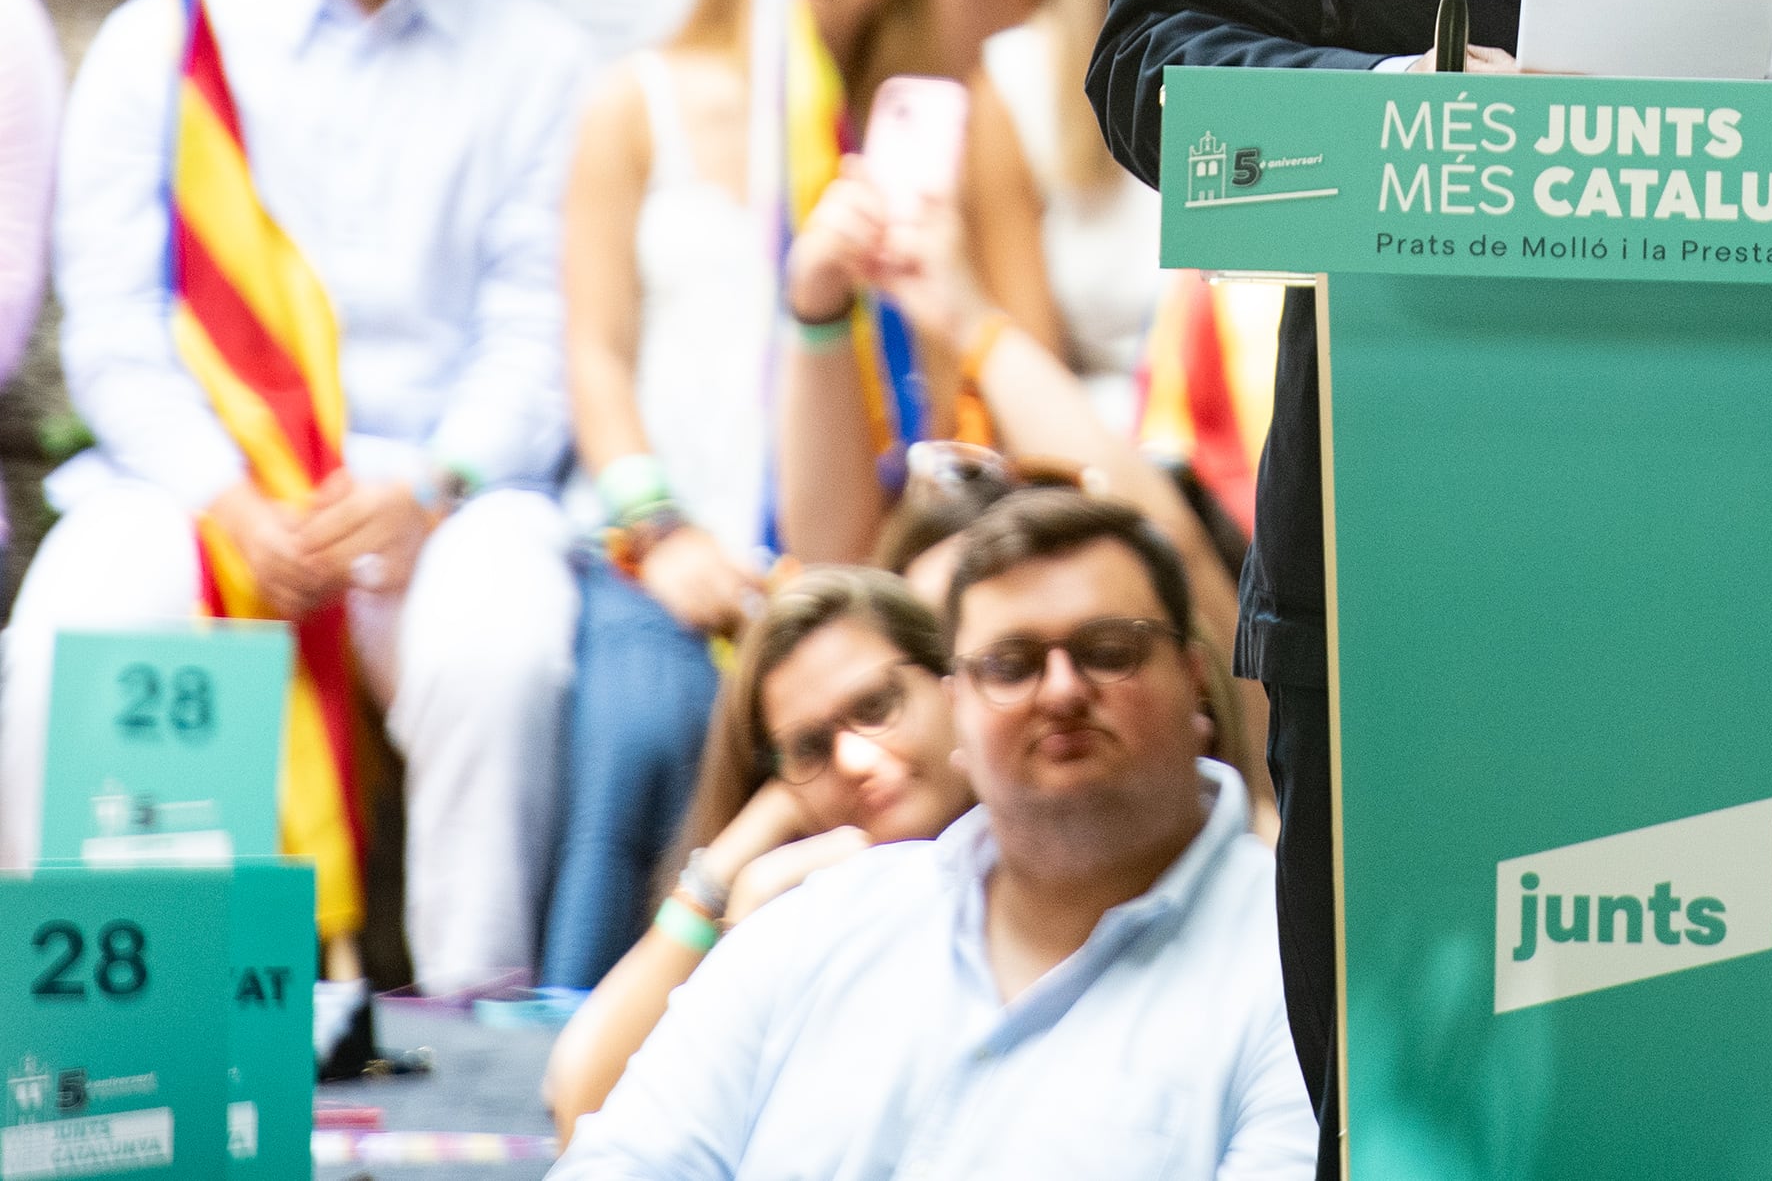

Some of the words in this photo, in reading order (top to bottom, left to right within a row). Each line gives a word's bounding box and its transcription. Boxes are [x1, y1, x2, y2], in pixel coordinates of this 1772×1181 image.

[1380, 91, 1517, 153] MÉS
[1533, 104, 1743, 159] JUNTS
[1268, 153, 1323, 169] aniversari
[1378, 154, 1515, 215] MÉS
[1376, 232, 1456, 257] Prats
[1469, 234, 1508, 257] de
[1522, 235, 1608, 260] Molló
[1621, 237, 1628, 260] i
[1642, 237, 1667, 261] la
[117, 662, 215, 738] 28
[1512, 870, 1728, 963] junts
[30, 918, 149, 999] 28
